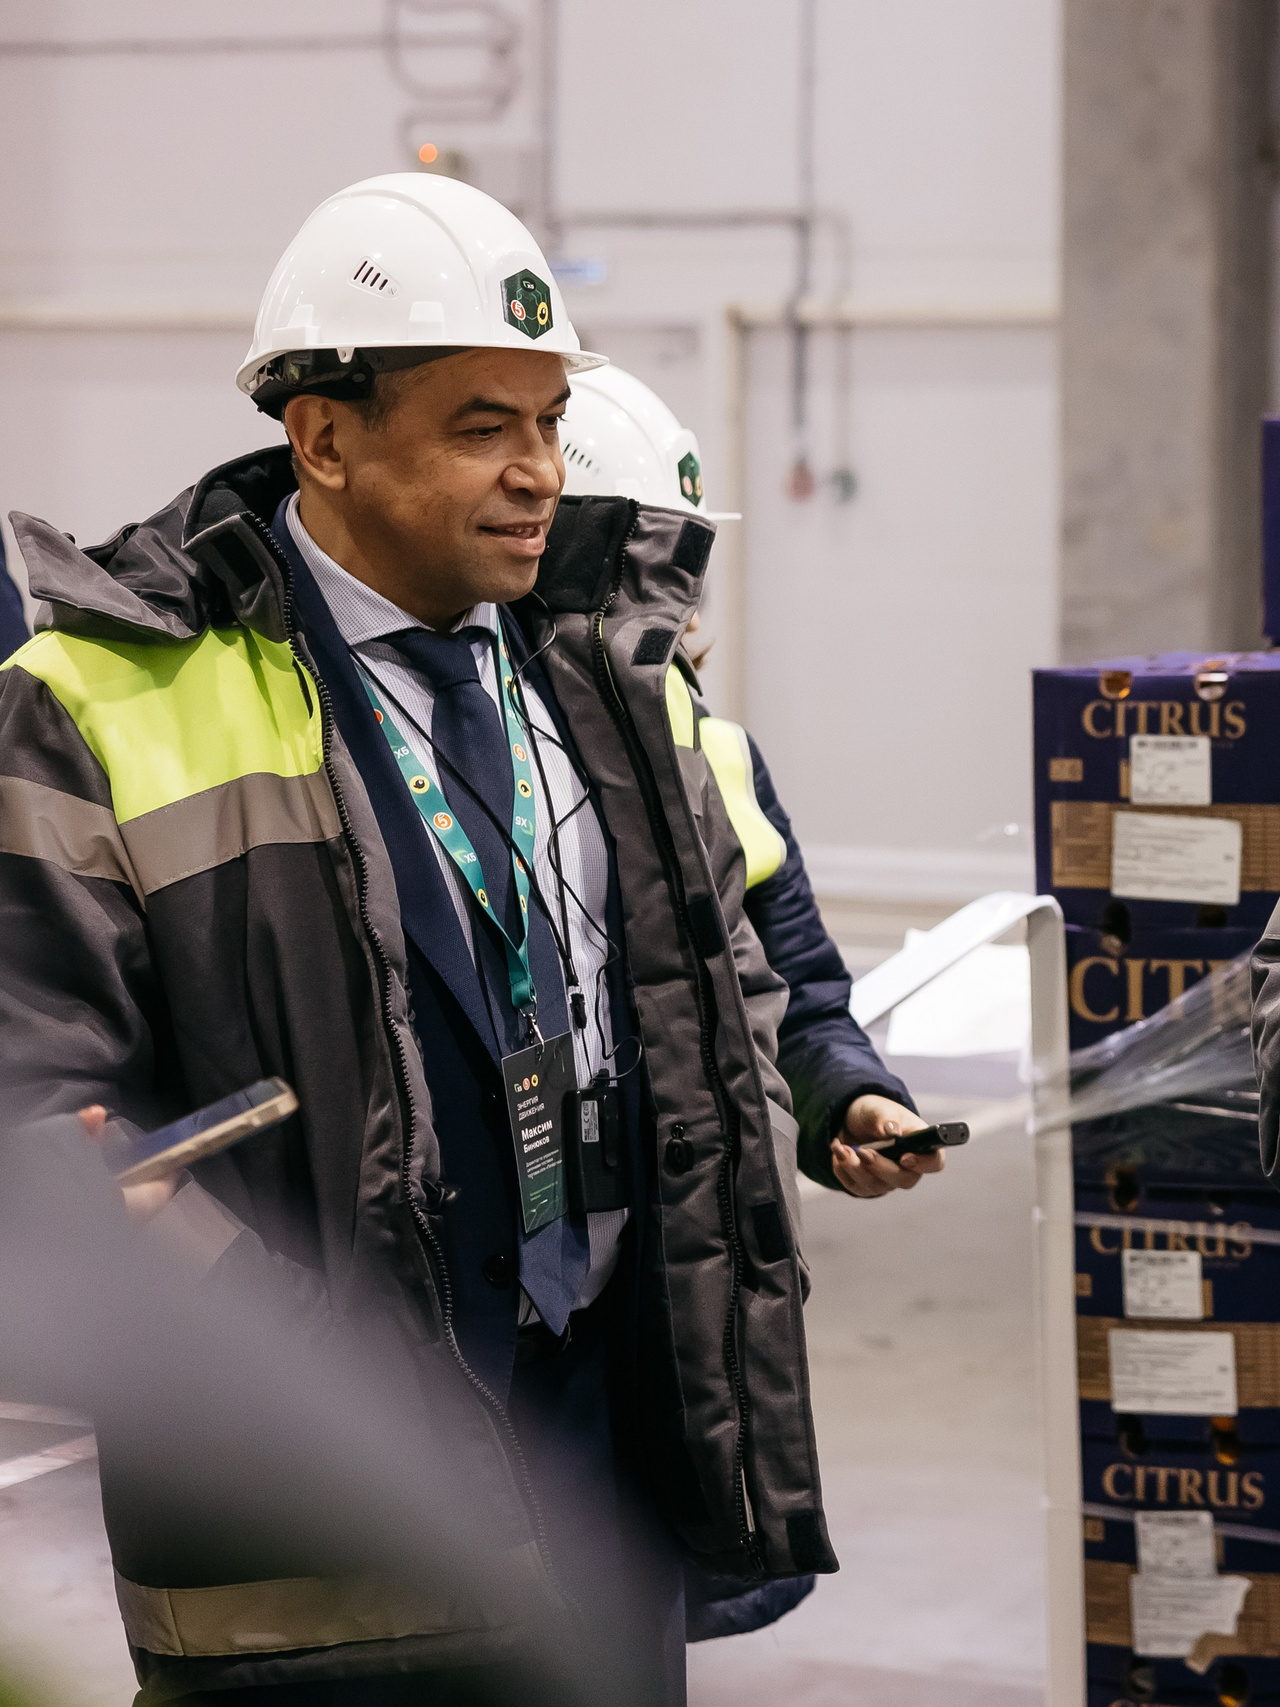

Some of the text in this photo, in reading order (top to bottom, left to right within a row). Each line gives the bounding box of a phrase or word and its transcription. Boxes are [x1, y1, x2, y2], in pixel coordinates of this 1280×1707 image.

[1082, 700, 1248, 739] CITRUS
[394, 746, 410, 759] X5
[464, 852, 477, 864] X5
[517, 1096, 538, 1111] ЭНЕРГИЯ
[521, 1119, 553, 1141] Максим
[1102, 1463, 1265, 1509] CITRUS
